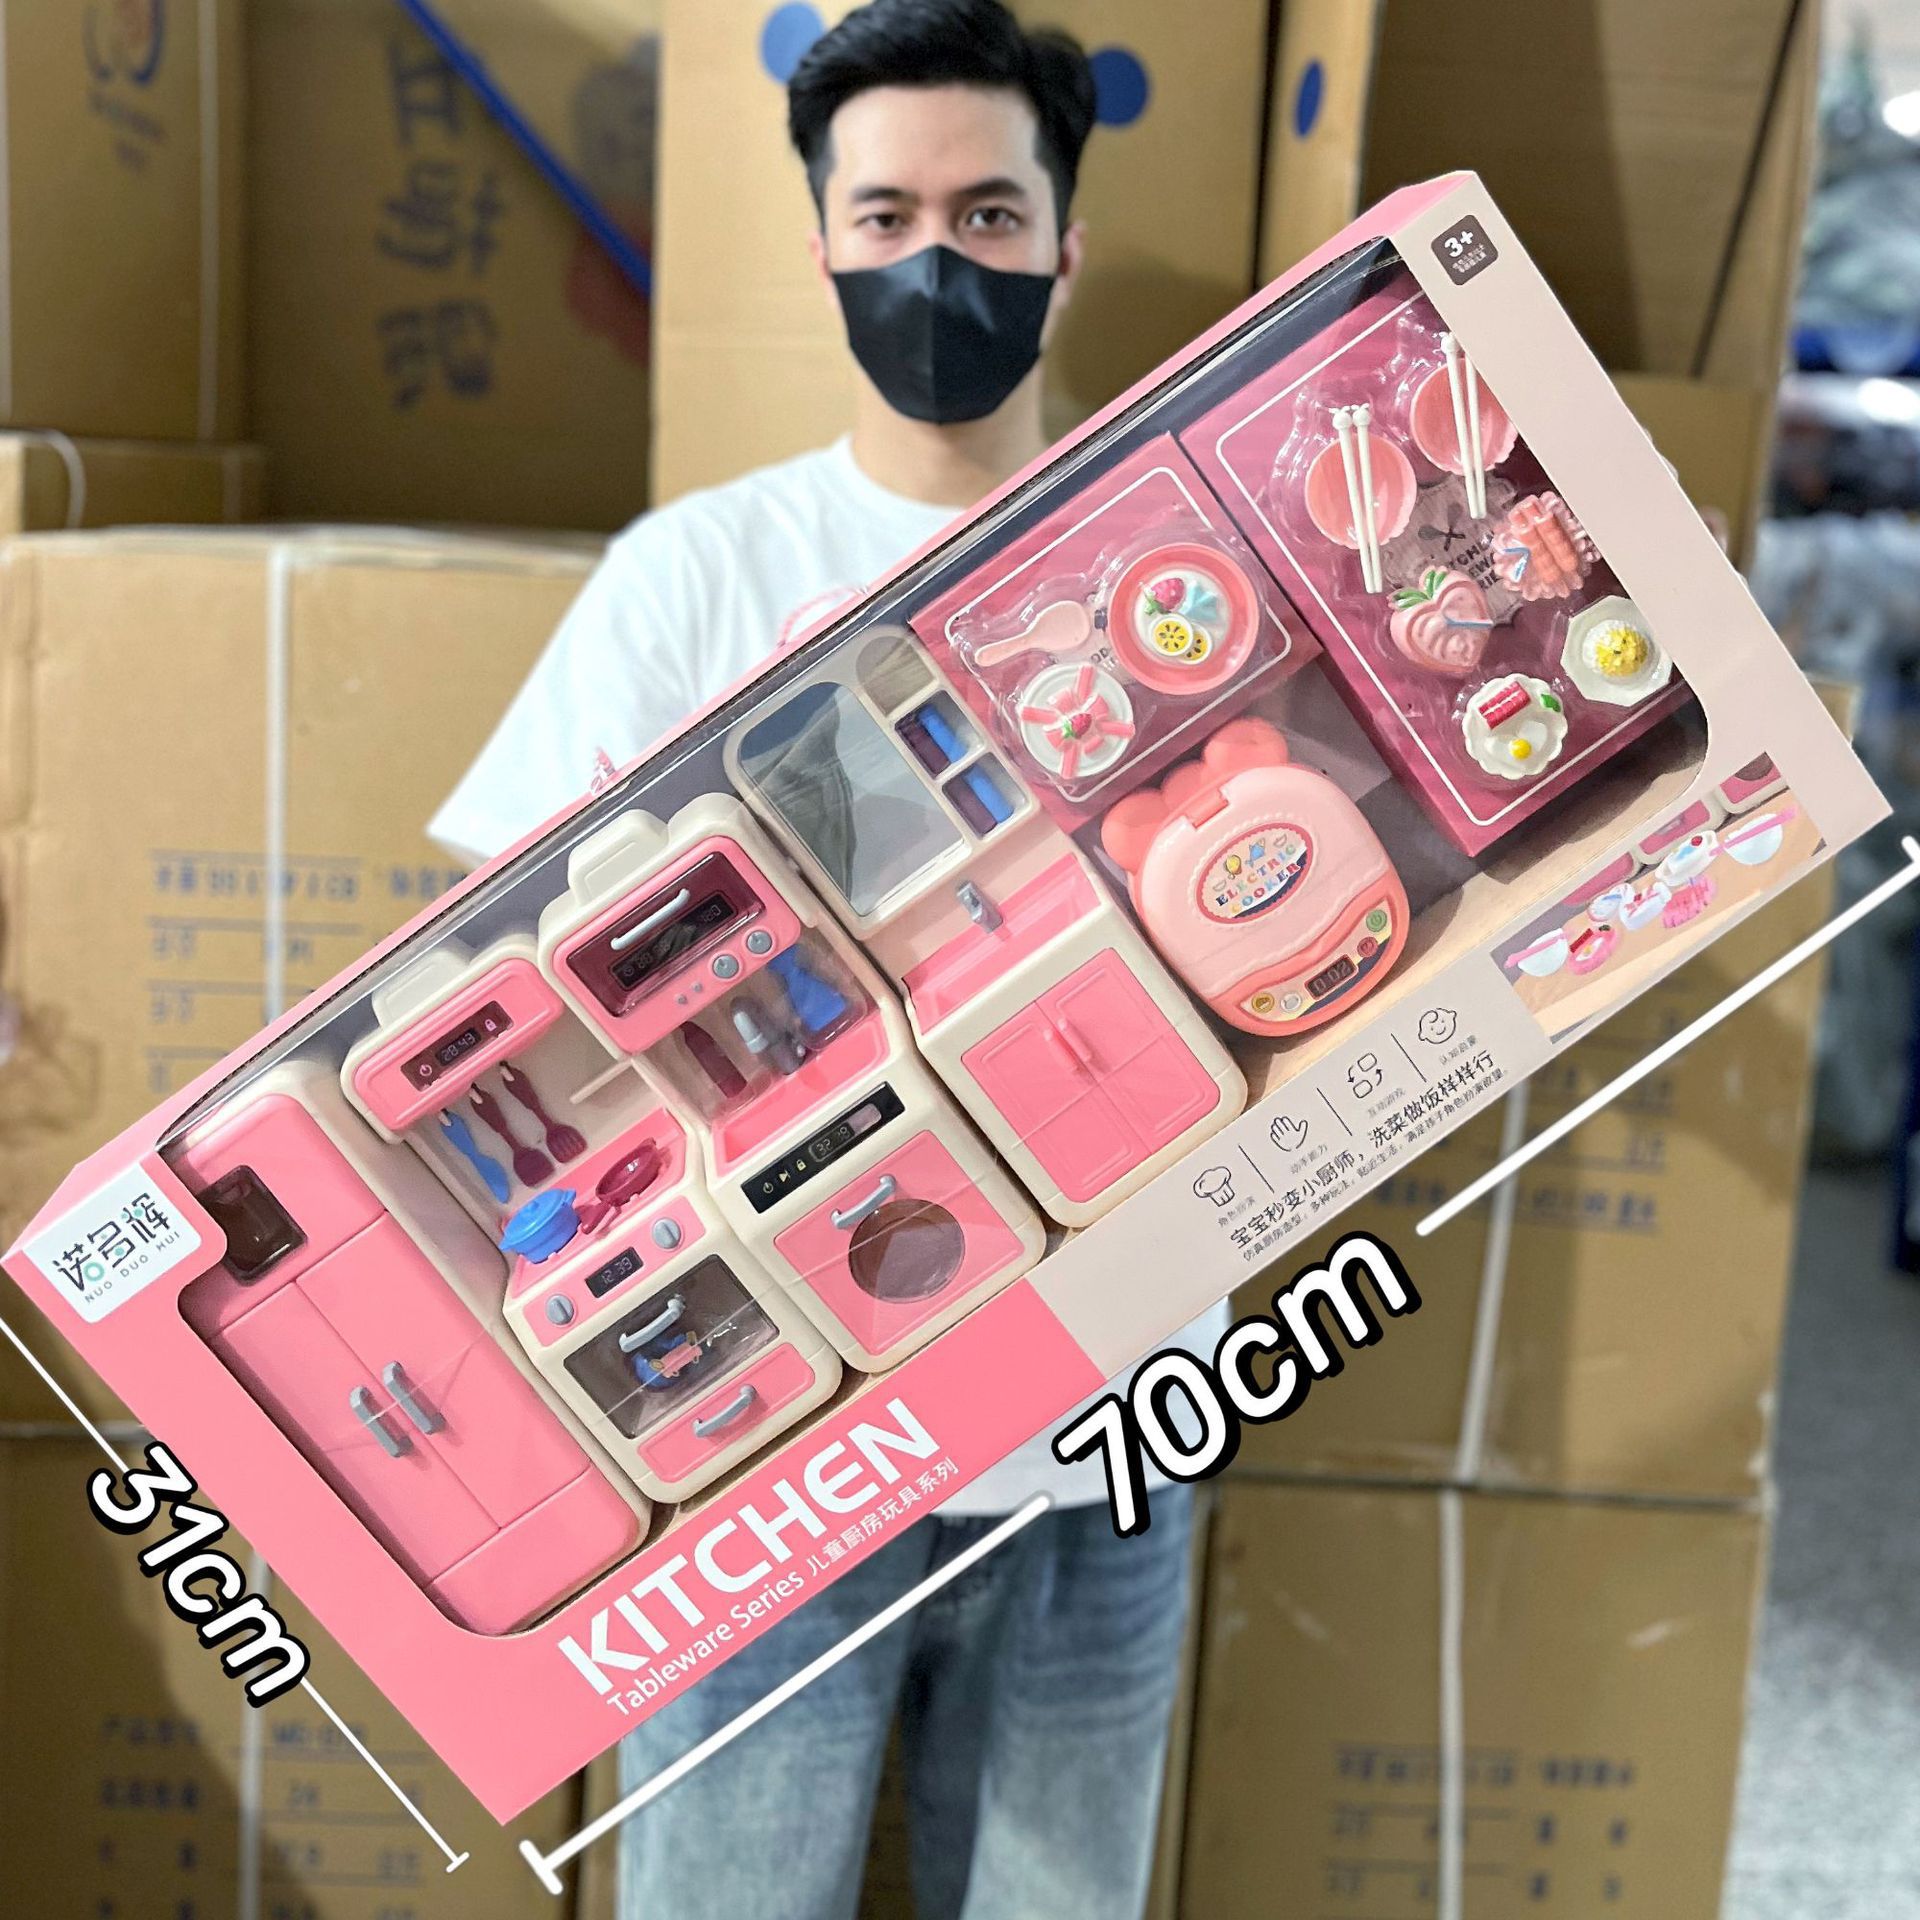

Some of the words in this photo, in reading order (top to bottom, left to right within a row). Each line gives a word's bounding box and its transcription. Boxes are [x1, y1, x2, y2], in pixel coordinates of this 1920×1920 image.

[1444, 231, 1473, 257] 3+
[1216, 844, 1296, 906] ELECTRIC
[1229, 863, 1301, 914] COOKER
[85, 1281, 113, 1303] NUO
[119, 1254, 149, 1278] DUO
[155, 1231, 180, 1252] HUI
[557, 1397, 941, 1695] KITCHEN
[606, 1623, 734, 1716] Tableware
[730, 1570, 804, 1629] Series
[806, 1457, 959, 1577] 儿童厨房玩具系列
